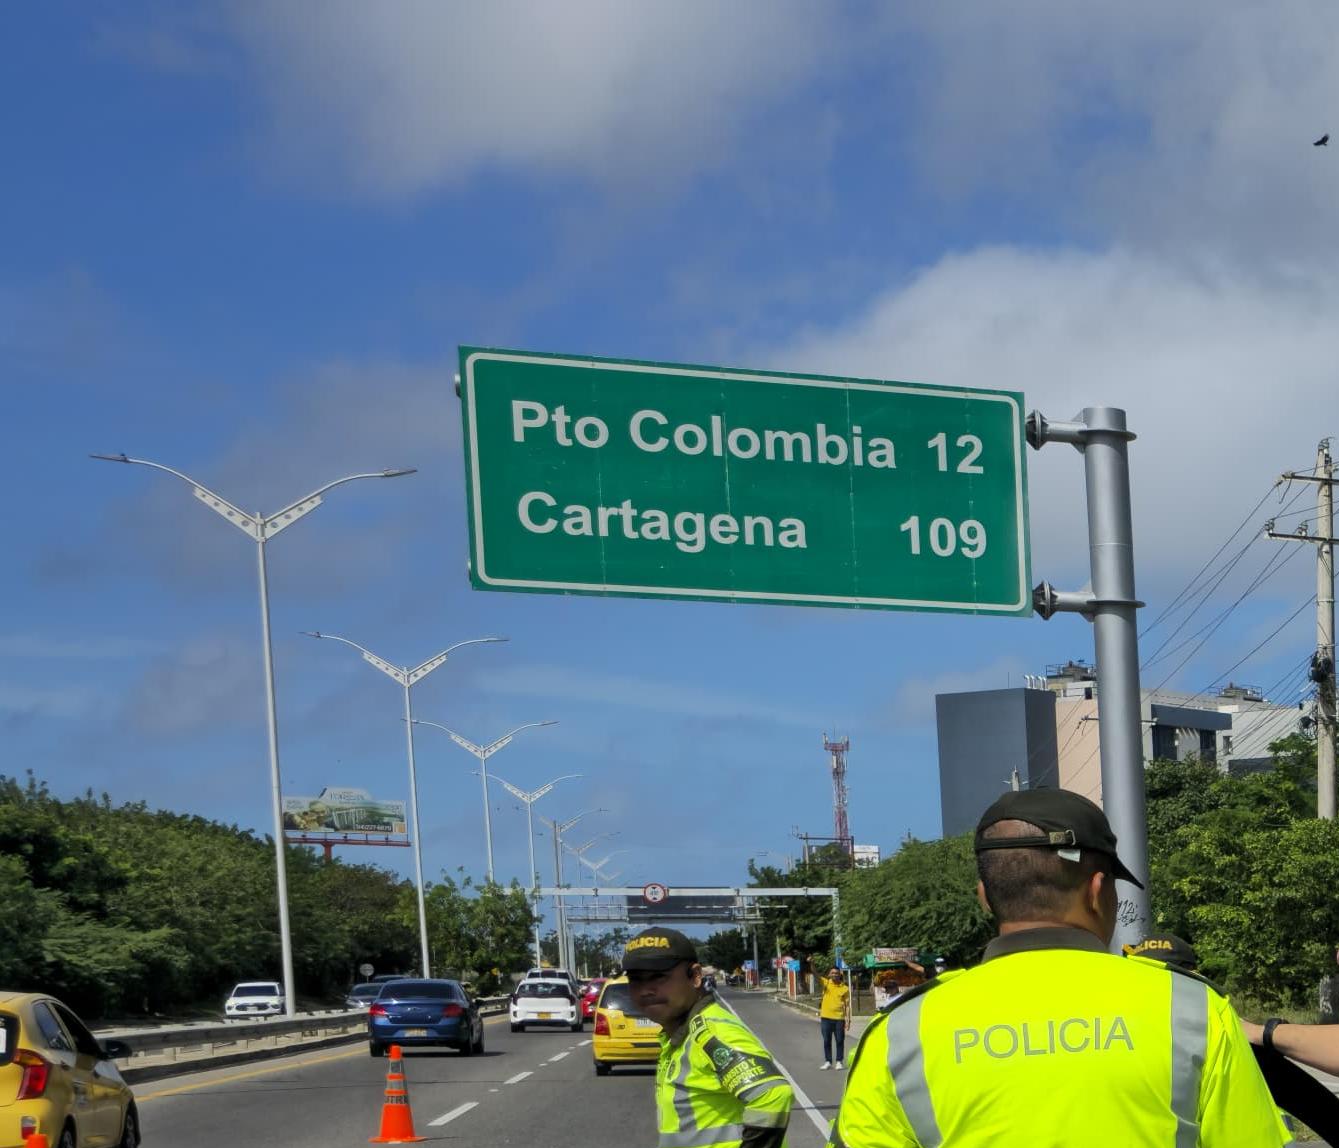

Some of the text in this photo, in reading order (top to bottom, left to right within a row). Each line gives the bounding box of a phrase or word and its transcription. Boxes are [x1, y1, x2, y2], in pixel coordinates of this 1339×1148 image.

[511, 400, 985, 475] Pto Colombia 12
[517, 491, 987, 559] Cartagena 109
[954, 1016, 1135, 1064] POLICIA
